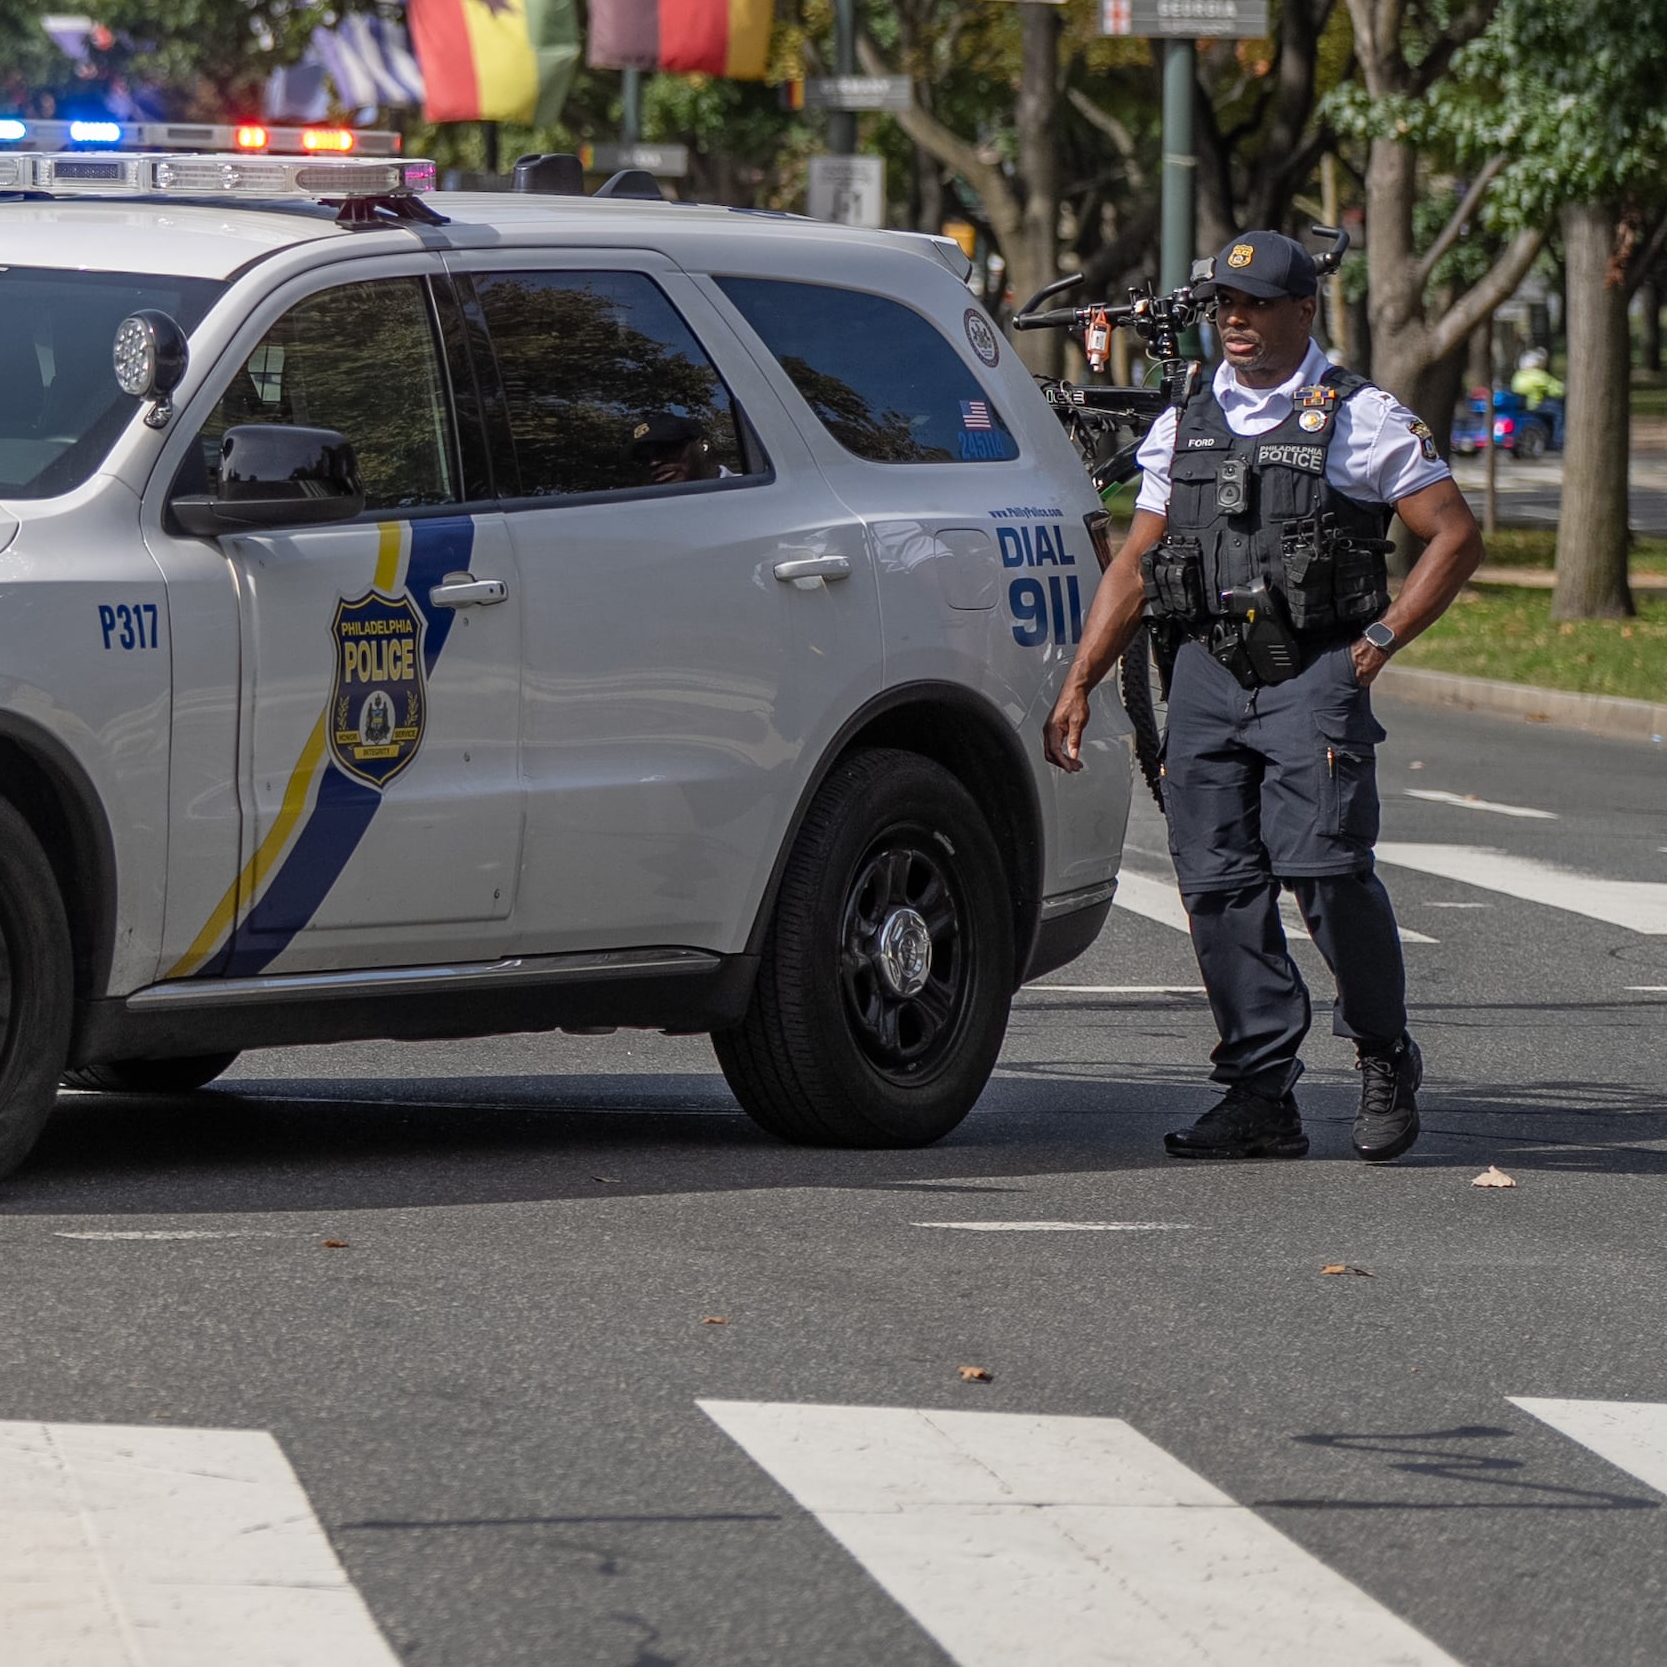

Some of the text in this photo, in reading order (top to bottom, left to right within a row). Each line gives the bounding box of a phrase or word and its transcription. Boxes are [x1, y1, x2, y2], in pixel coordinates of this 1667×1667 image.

[1187, 438, 1215, 448] FORD
[1259, 445, 1323, 457] PHILADELPHIA
[1258, 449, 1323, 471] POLICE
[996, 525, 1076, 568] DIAL
[98, 604, 157, 650] P317
[1009, 574, 1084, 648] 911
[341, 619, 413, 637] PHILADELPHIA
[344, 638, 414, 683] POLICE
